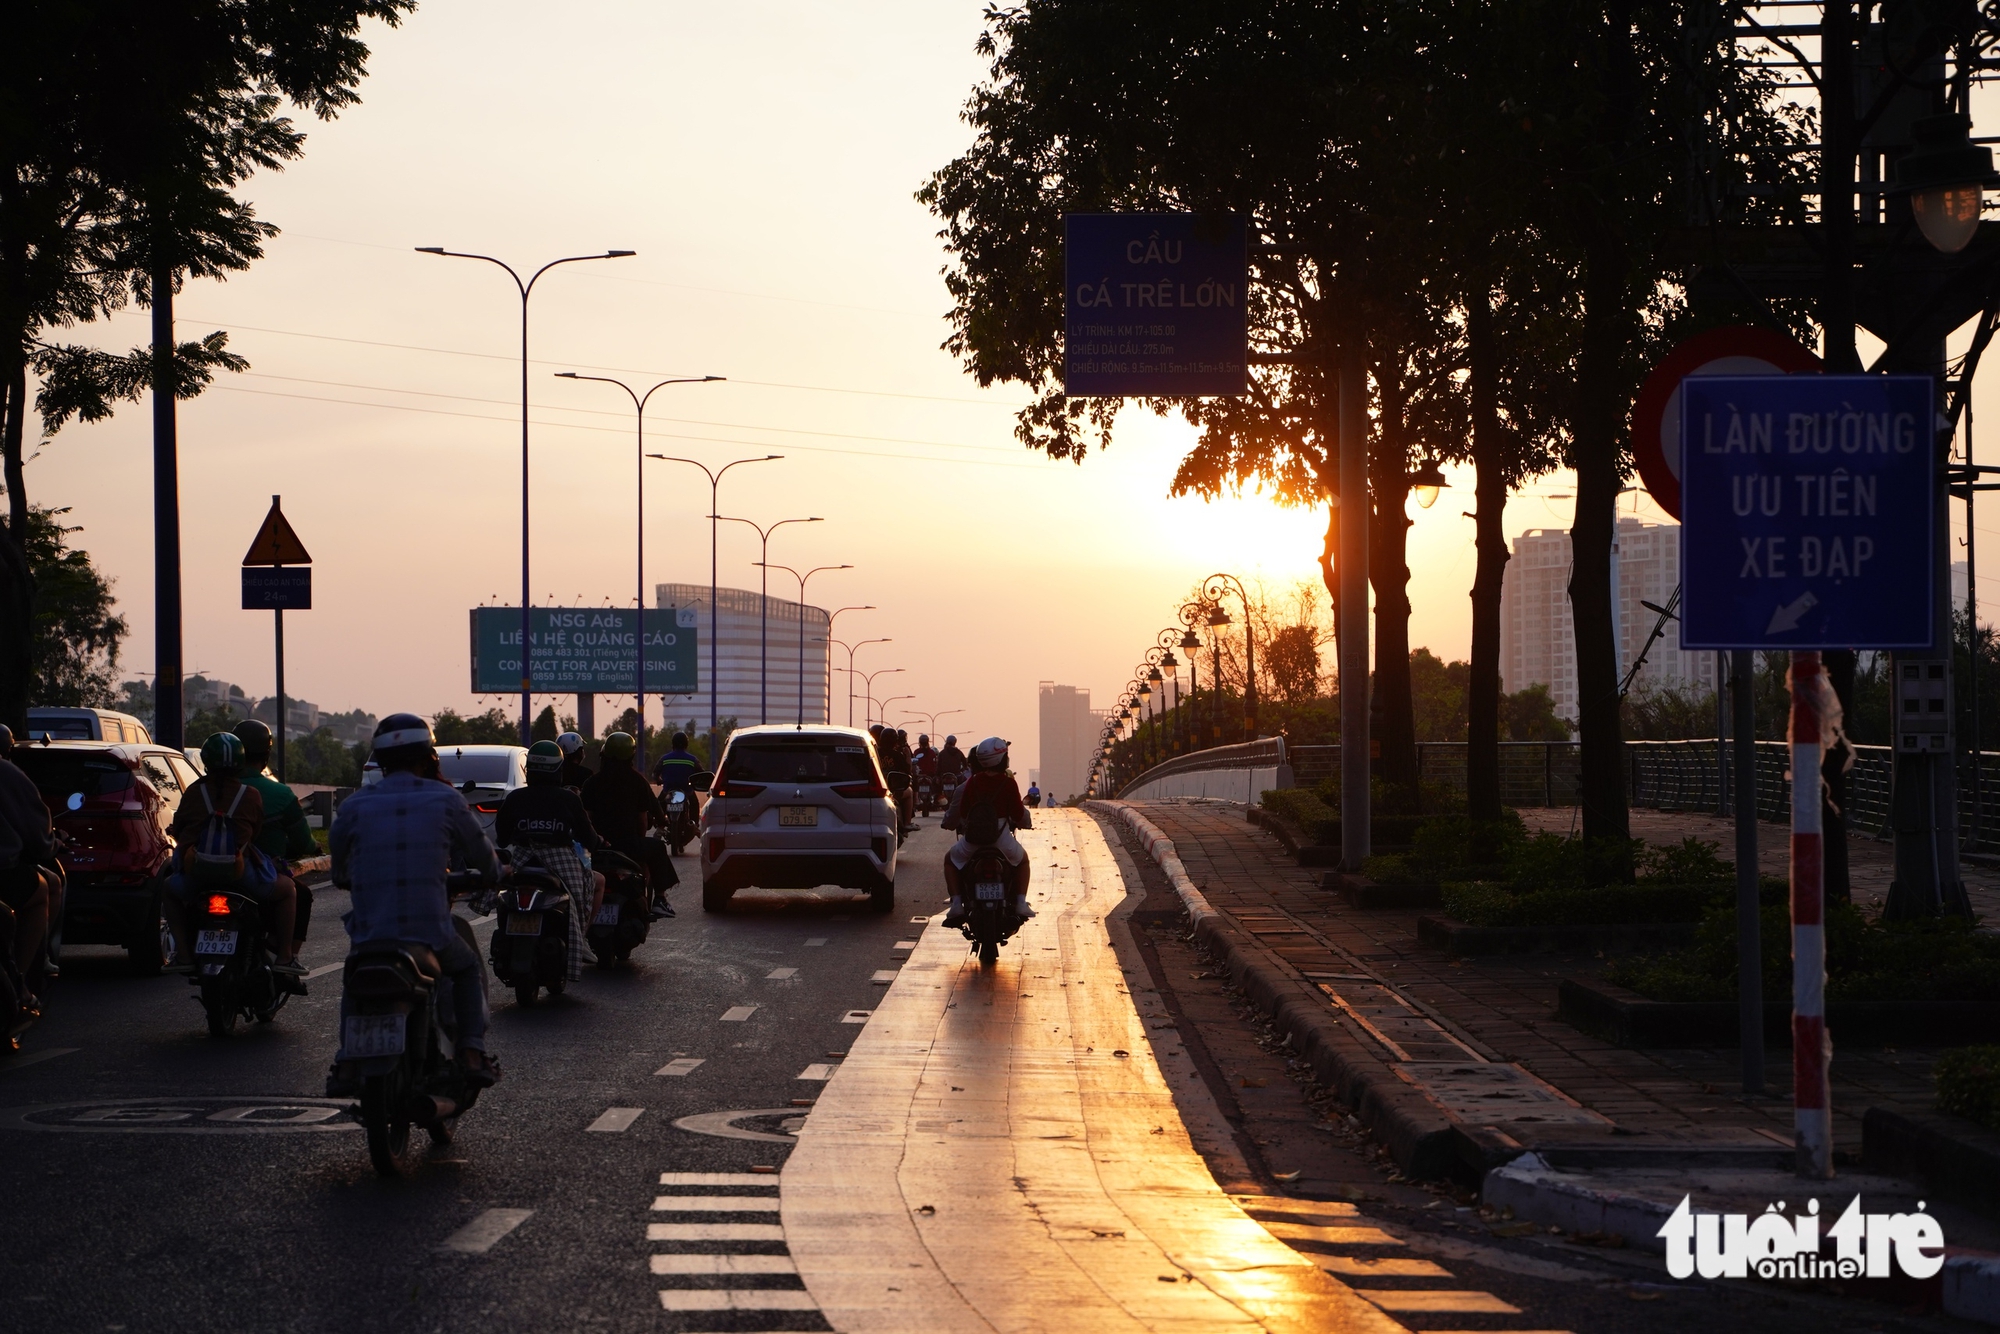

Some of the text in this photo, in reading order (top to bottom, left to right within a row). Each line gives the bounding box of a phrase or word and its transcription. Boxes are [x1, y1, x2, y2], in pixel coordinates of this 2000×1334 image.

[1126, 229, 1183, 264] CẦU
[1076, 277, 1235, 308] CÁ TRÊ LỚN
[1071, 323, 1176, 336] LÝ TRÌNH: KM 17+105.00
[1071, 340, 1174, 355] CHIỀU DÀI CẦU: 275.0m
[1071, 358, 1099, 373] CHIỀU
[1101, 361, 1130, 375] RỘNG:
[1703, 401, 1915, 455] LÀN ĐƯỜNG
[1732, 467, 1877, 517] ƯU TIÊN
[1739, 536, 1875, 585] XE ĐẠP
[264, 578, 279, 587] CAO
[280, 578, 291, 587] AN
[549, 613, 623, 628] NSG Ads
[499, 629, 677, 648] LIÊN HỆ QUẢNG CÁO
[531, 648, 553, 657] 0868
[555, 648, 572, 657] 483
[574, 648, 591, 657] 301
[592, 647, 620, 658] (Tiếng
[562, 660, 588, 671] FOR
[532, 672, 633, 682] 0859 155 759 (English)
[790, 807, 806, 816] 50E
[783, 816, 814, 824] 079.15
[979, 891, 1000, 899] 0058
[203, 931, 231, 942] 60-H5
[197, 942, 233, 953] 029.29
[72, 1105, 342, 1123] 60
